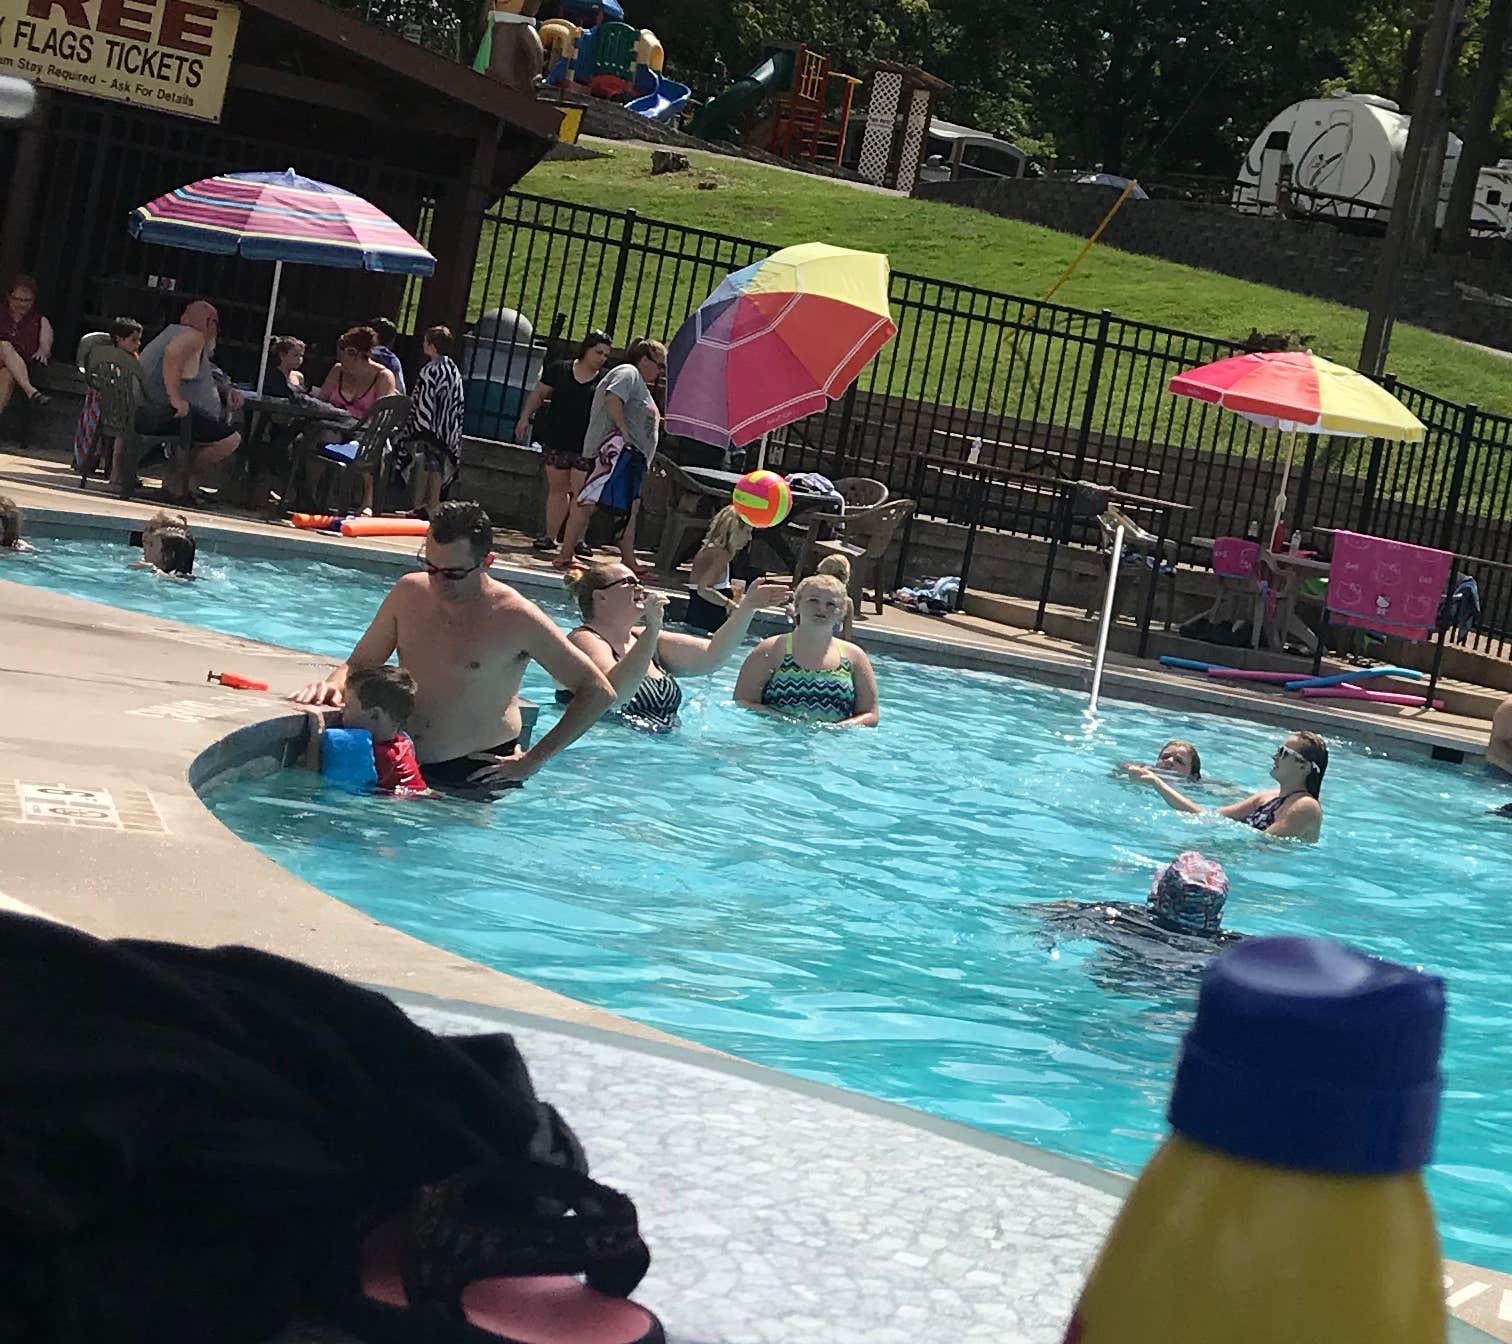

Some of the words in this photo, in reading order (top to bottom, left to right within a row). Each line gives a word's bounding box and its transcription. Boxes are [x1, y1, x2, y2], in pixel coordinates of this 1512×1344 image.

[14, 20, 94, 63] FLAGS
[105, 39, 204, 88] TICKETS
[17, 57, 43, 74] Stay
[47, 64, 96, 84] Required
[110, 78, 131, 92] Ask
[135, 83, 153, 97] For
[157, 88, 194, 107] Details
